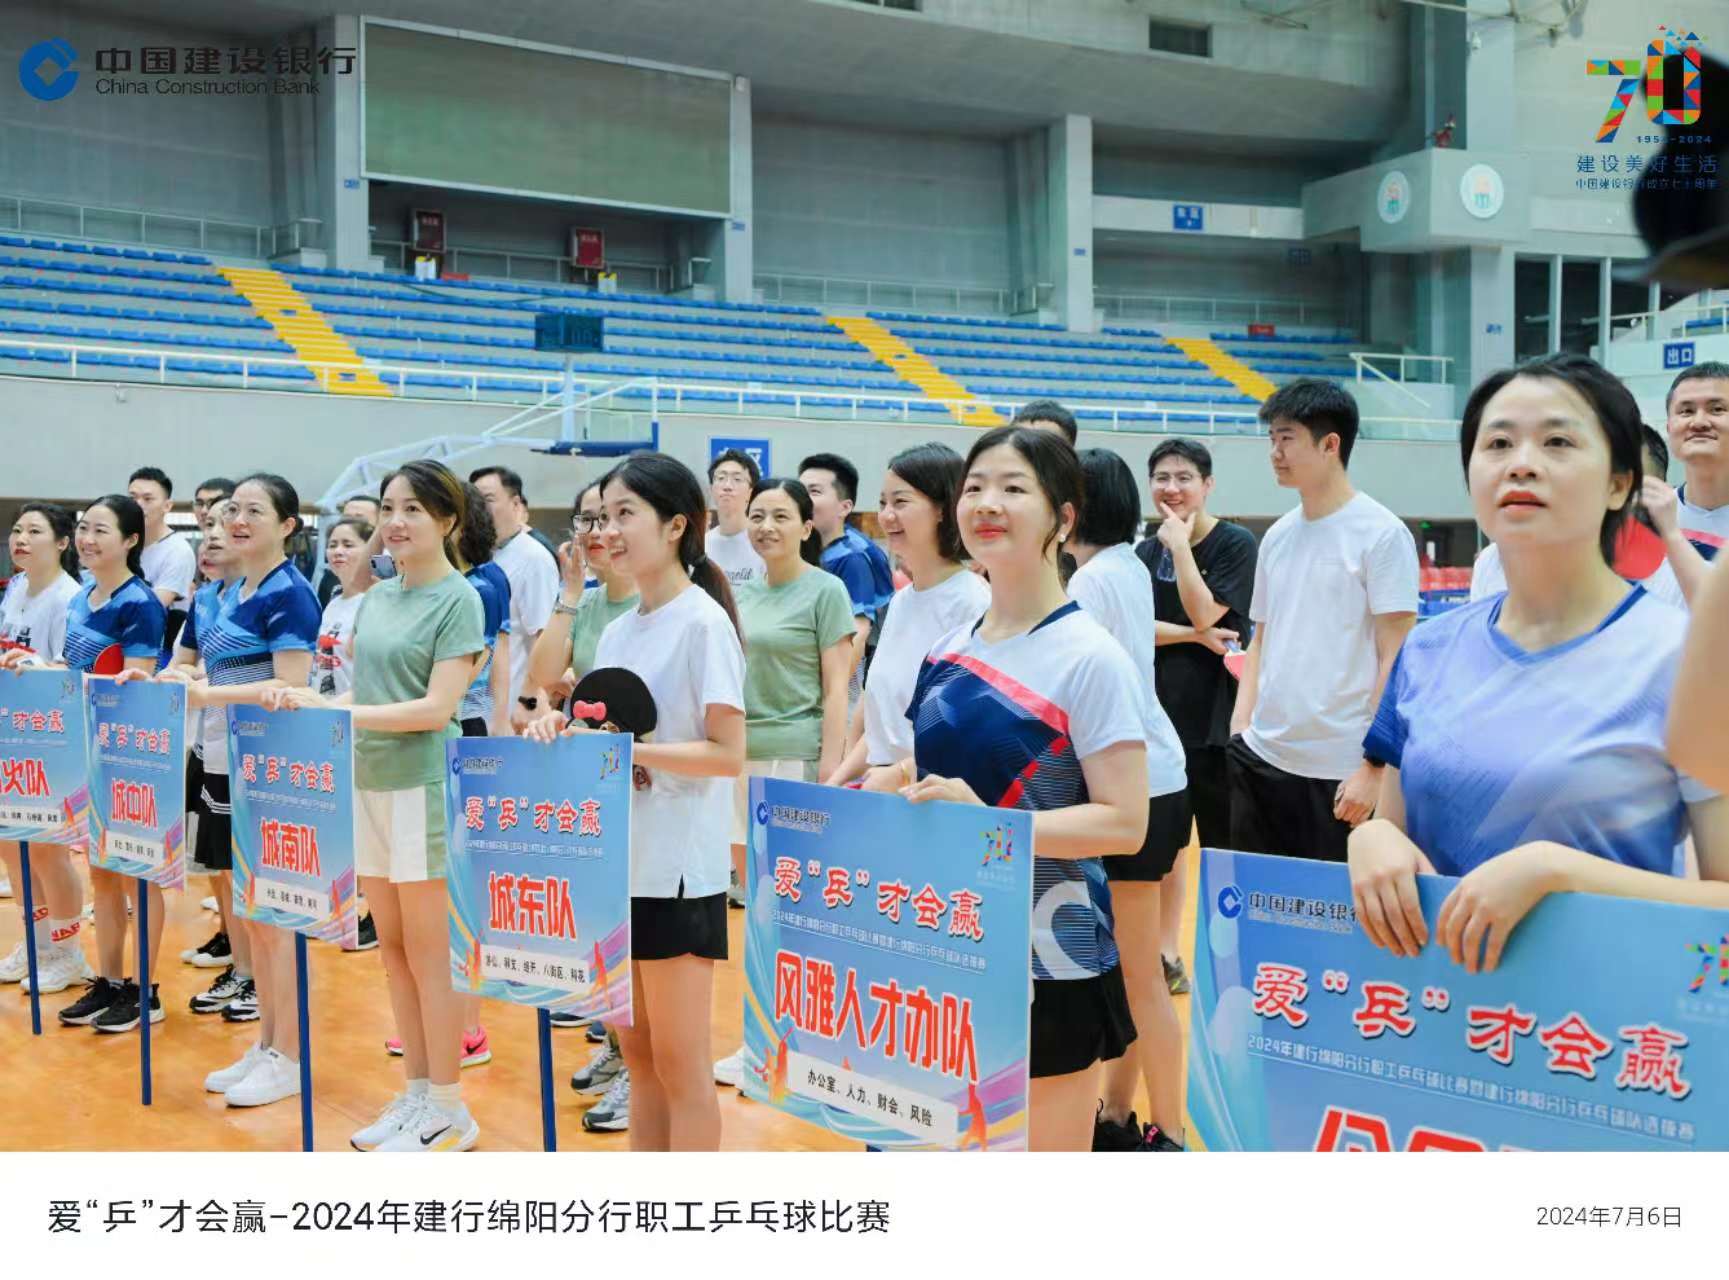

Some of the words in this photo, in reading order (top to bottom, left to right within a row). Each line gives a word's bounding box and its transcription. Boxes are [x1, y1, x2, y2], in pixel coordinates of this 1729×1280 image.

[1667, 347, 1692, 365] 出口
[0, 758, 50, 797] 火队
[111, 777, 158, 831] 城中队
[260, 816, 321, 878] 城南队
[465, 796, 602, 837] 爱“乒”才会赢
[488, 871, 577, 940] 城东队
[774, 855, 985, 942] 爱“乒”才会赢
[775, 949, 980, 1086] 风雅人才办队
[1253, 961, 1692, 1099] 爱“乒”才会赢
[807, 1068, 934, 1128] 办公室、人力、财会、风险
